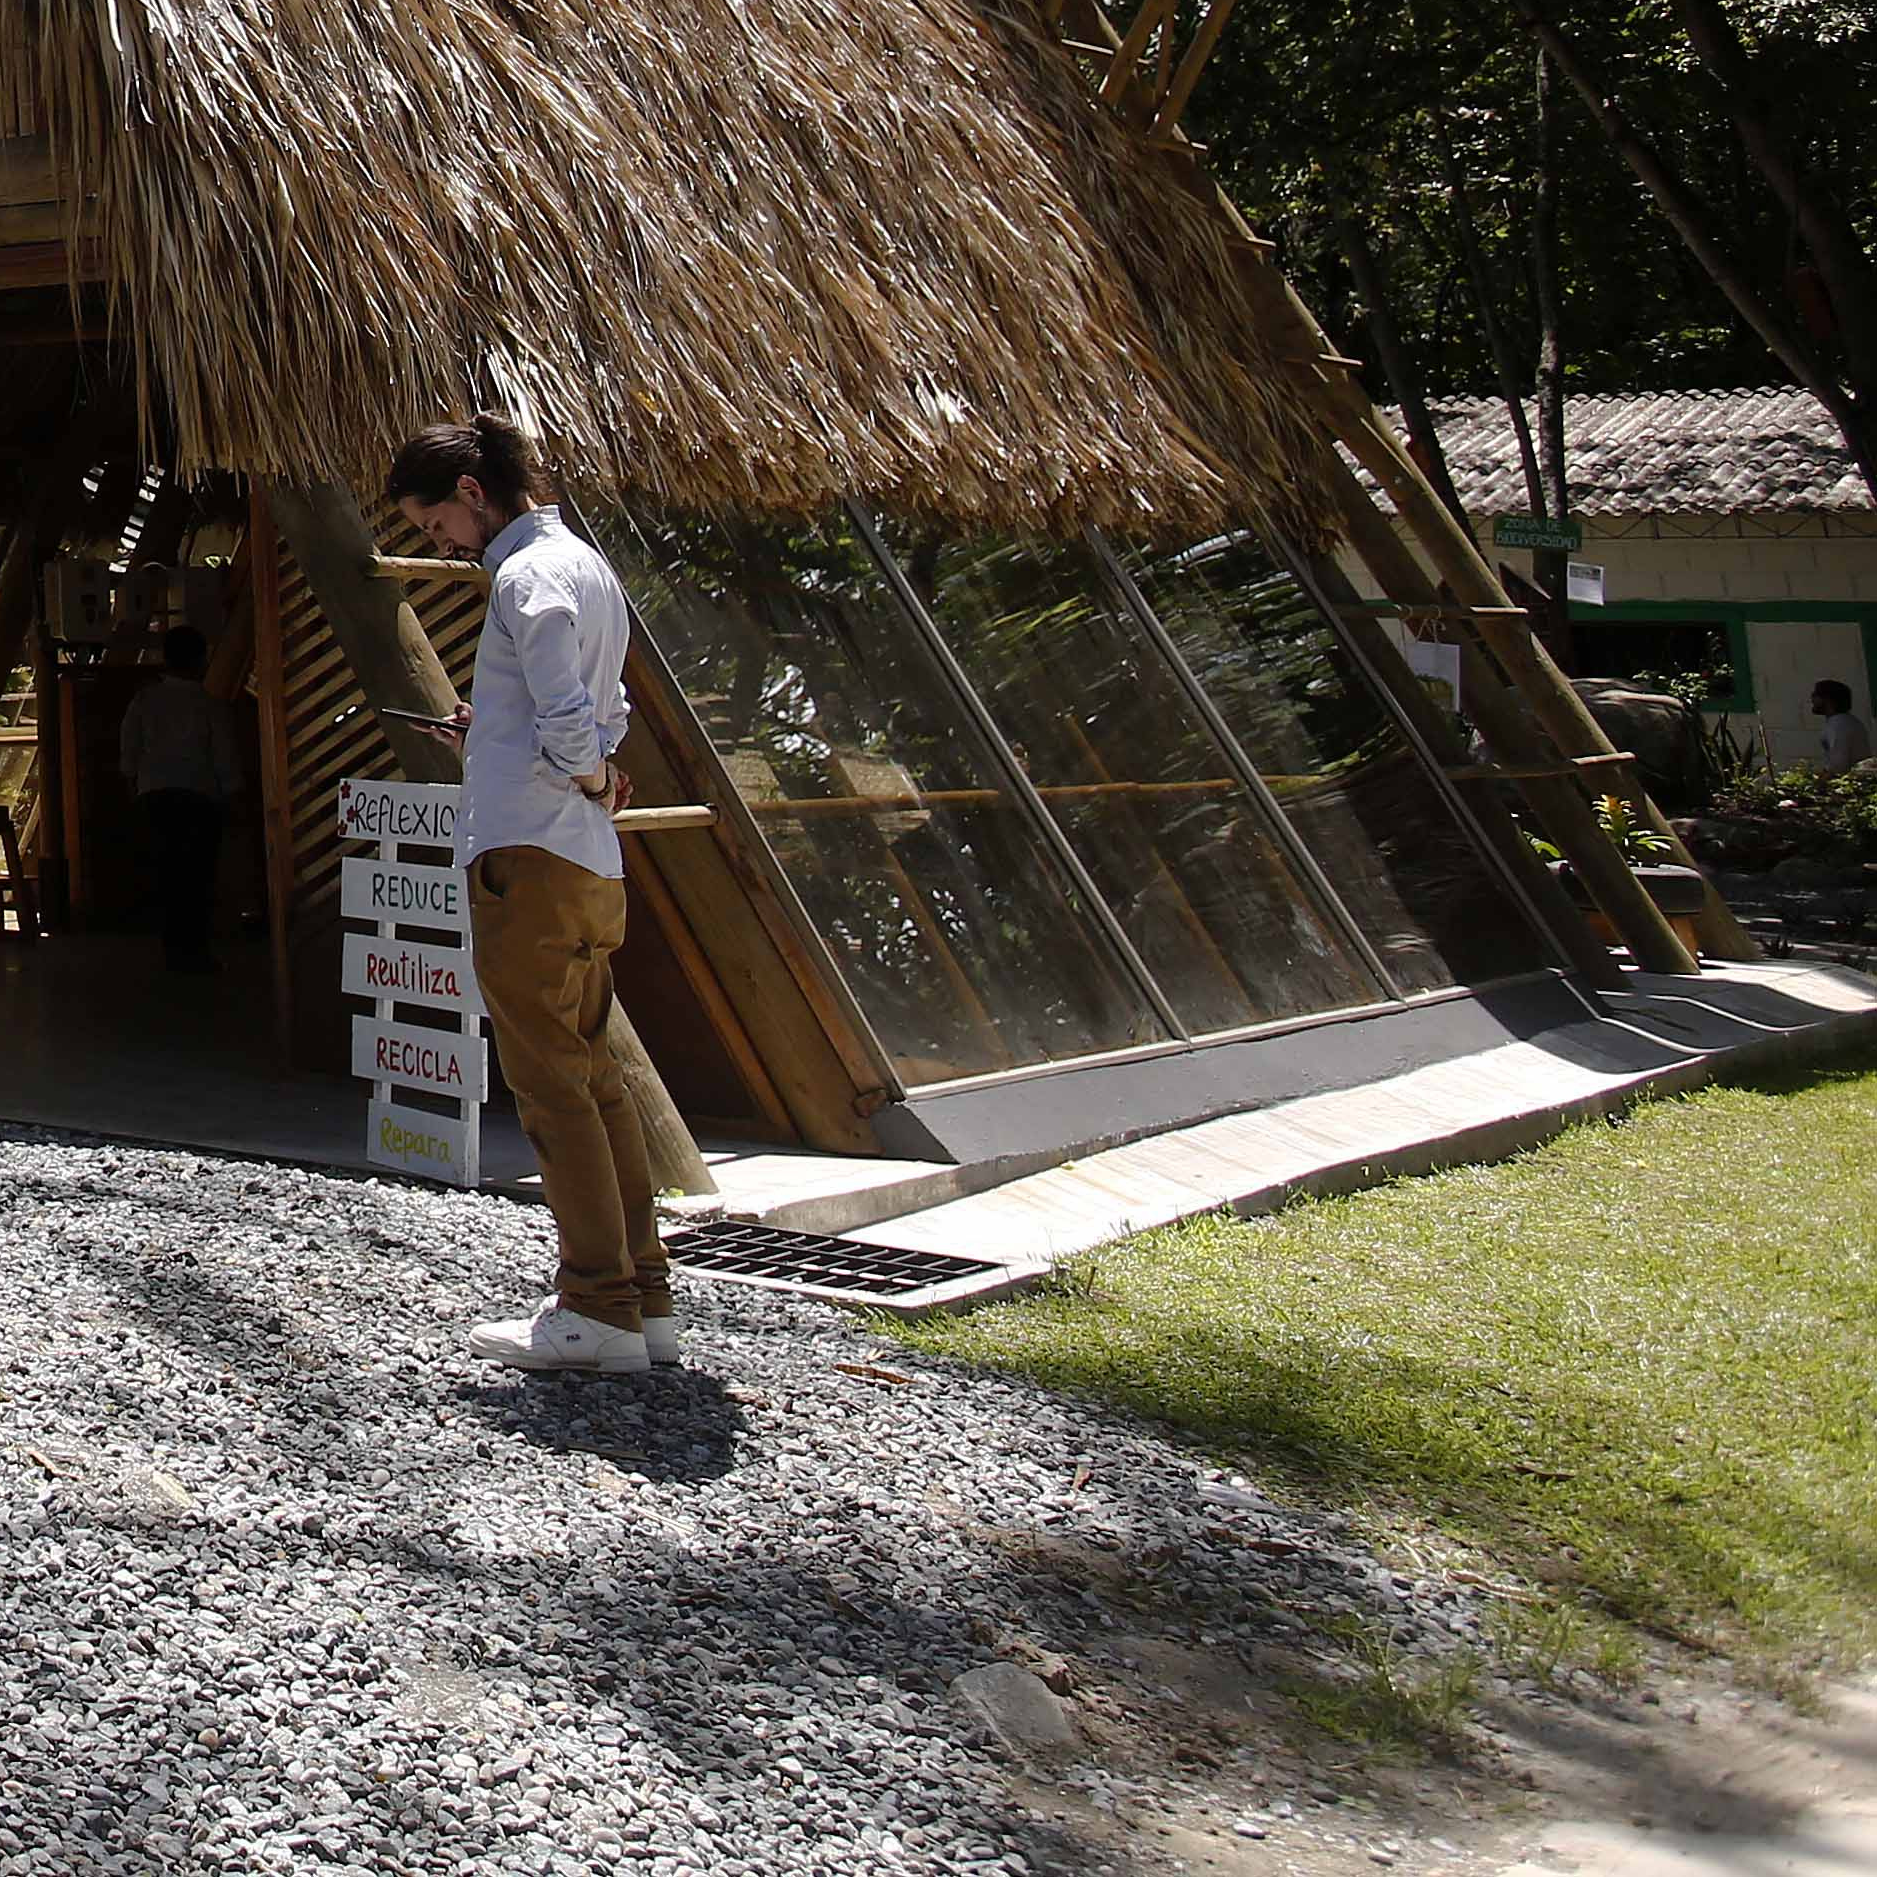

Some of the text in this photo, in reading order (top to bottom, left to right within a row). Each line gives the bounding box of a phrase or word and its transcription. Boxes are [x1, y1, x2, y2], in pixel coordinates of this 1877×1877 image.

[372, 873, 458, 915] REDUCE
[367, 951, 461, 997] Reutiliza
[376, 1036, 463, 1085] RECICLA
[380, 1117, 452, 1163] Repara
